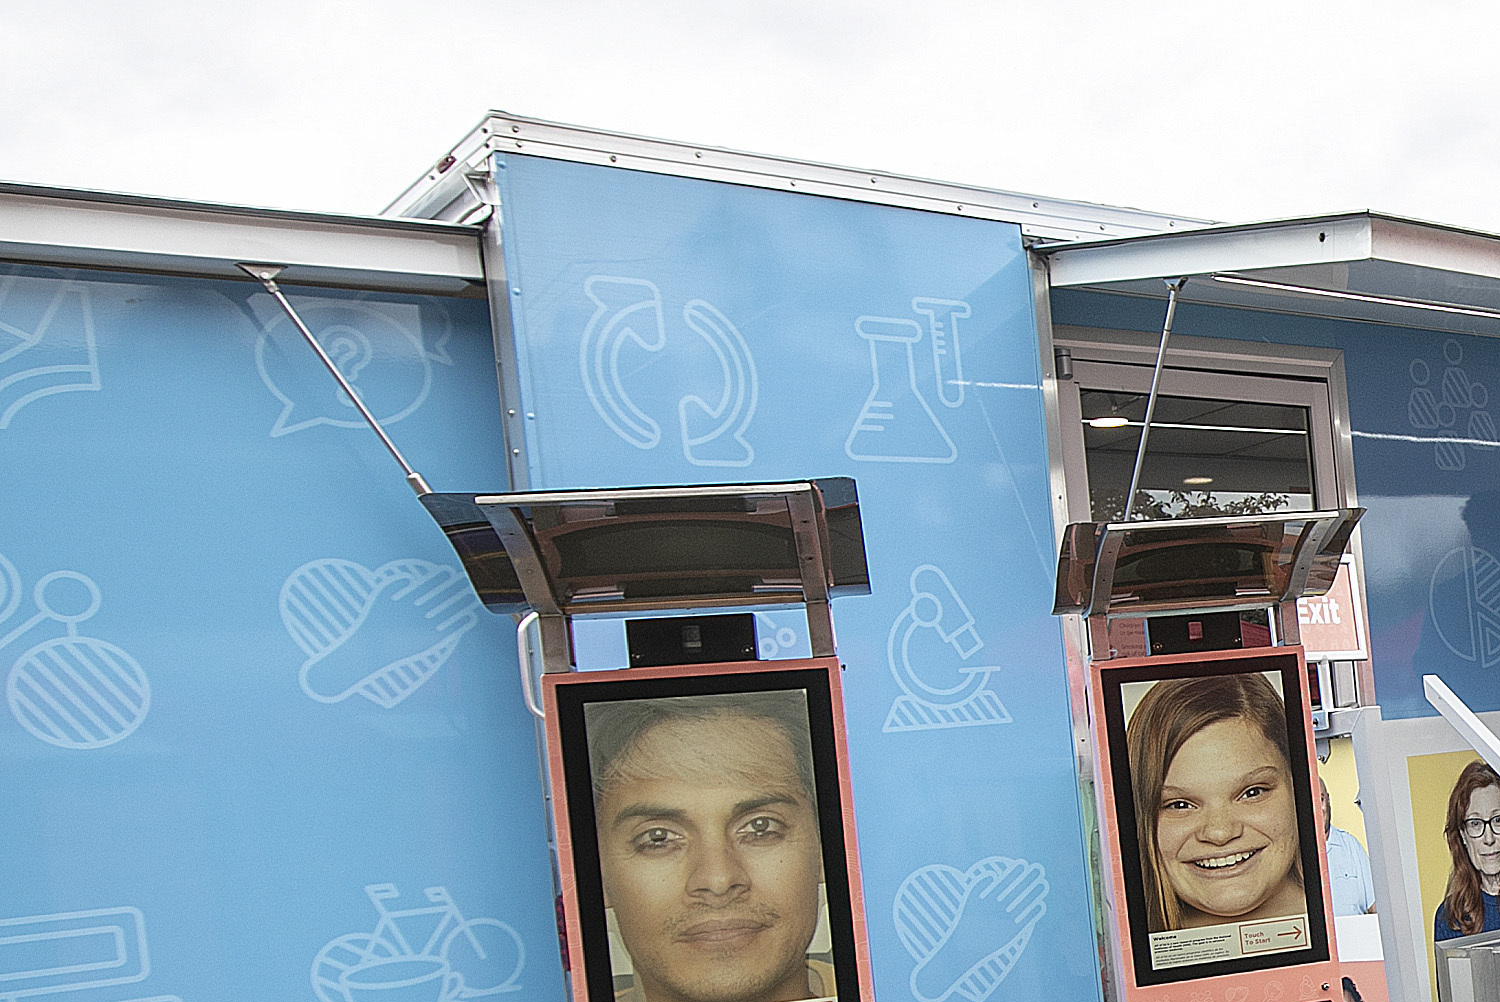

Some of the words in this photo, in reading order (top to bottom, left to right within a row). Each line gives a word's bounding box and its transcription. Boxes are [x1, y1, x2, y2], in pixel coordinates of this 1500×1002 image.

[1296, 597, 1341, 626] Exit
[1244, 931, 1264, 939] Touch
[1245, 938, 1254, 946] To
[1255, 936, 1271, 945] Start
